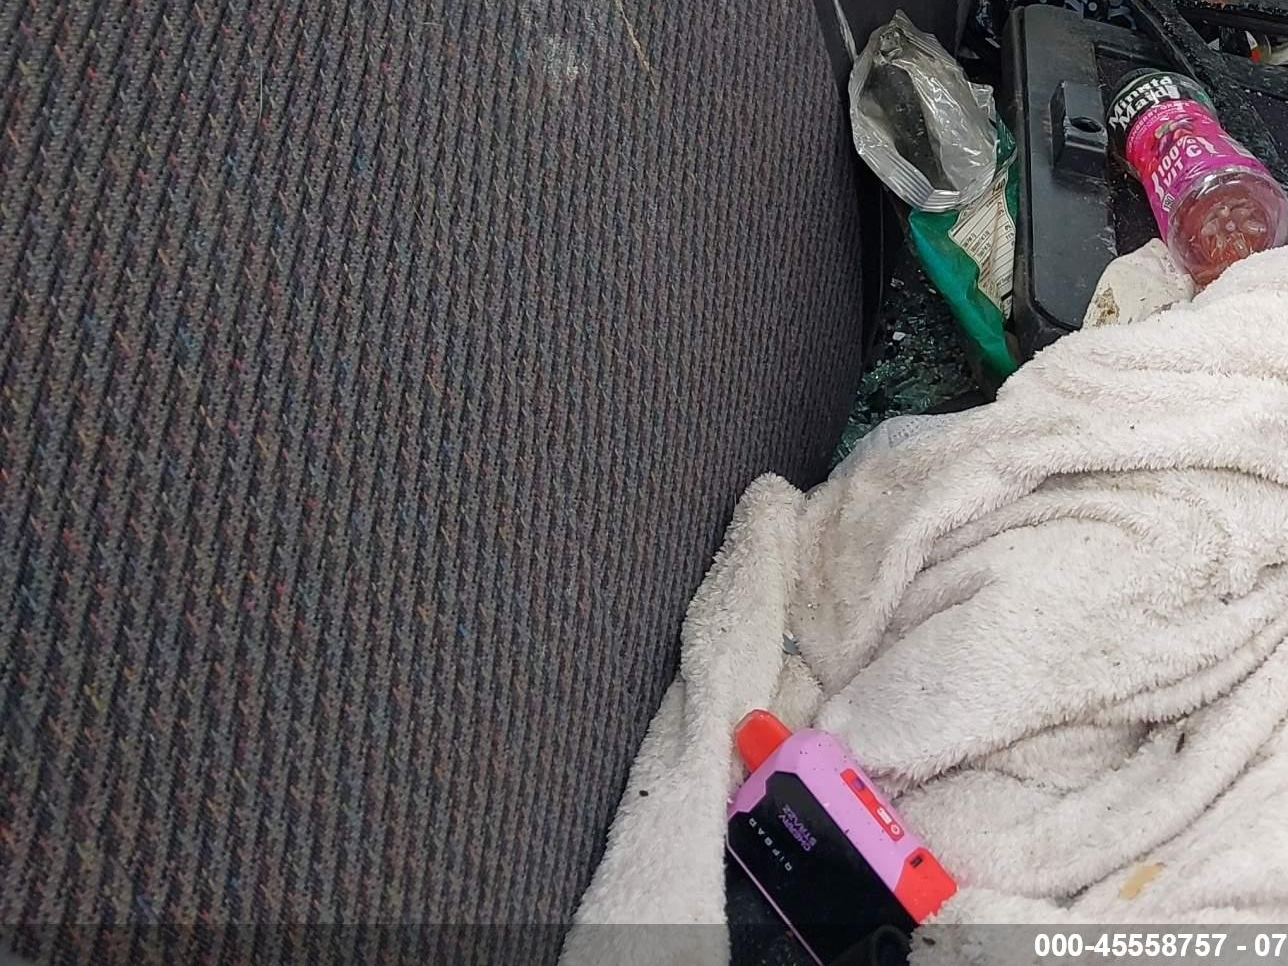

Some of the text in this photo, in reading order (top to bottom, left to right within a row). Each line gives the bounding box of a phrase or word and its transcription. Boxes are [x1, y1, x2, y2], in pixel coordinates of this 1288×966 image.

[1119, 85, 1179, 132] Maid
[1158, 135, 1197, 178] 100%
[1163, 144, 1203, 187] VIT C
